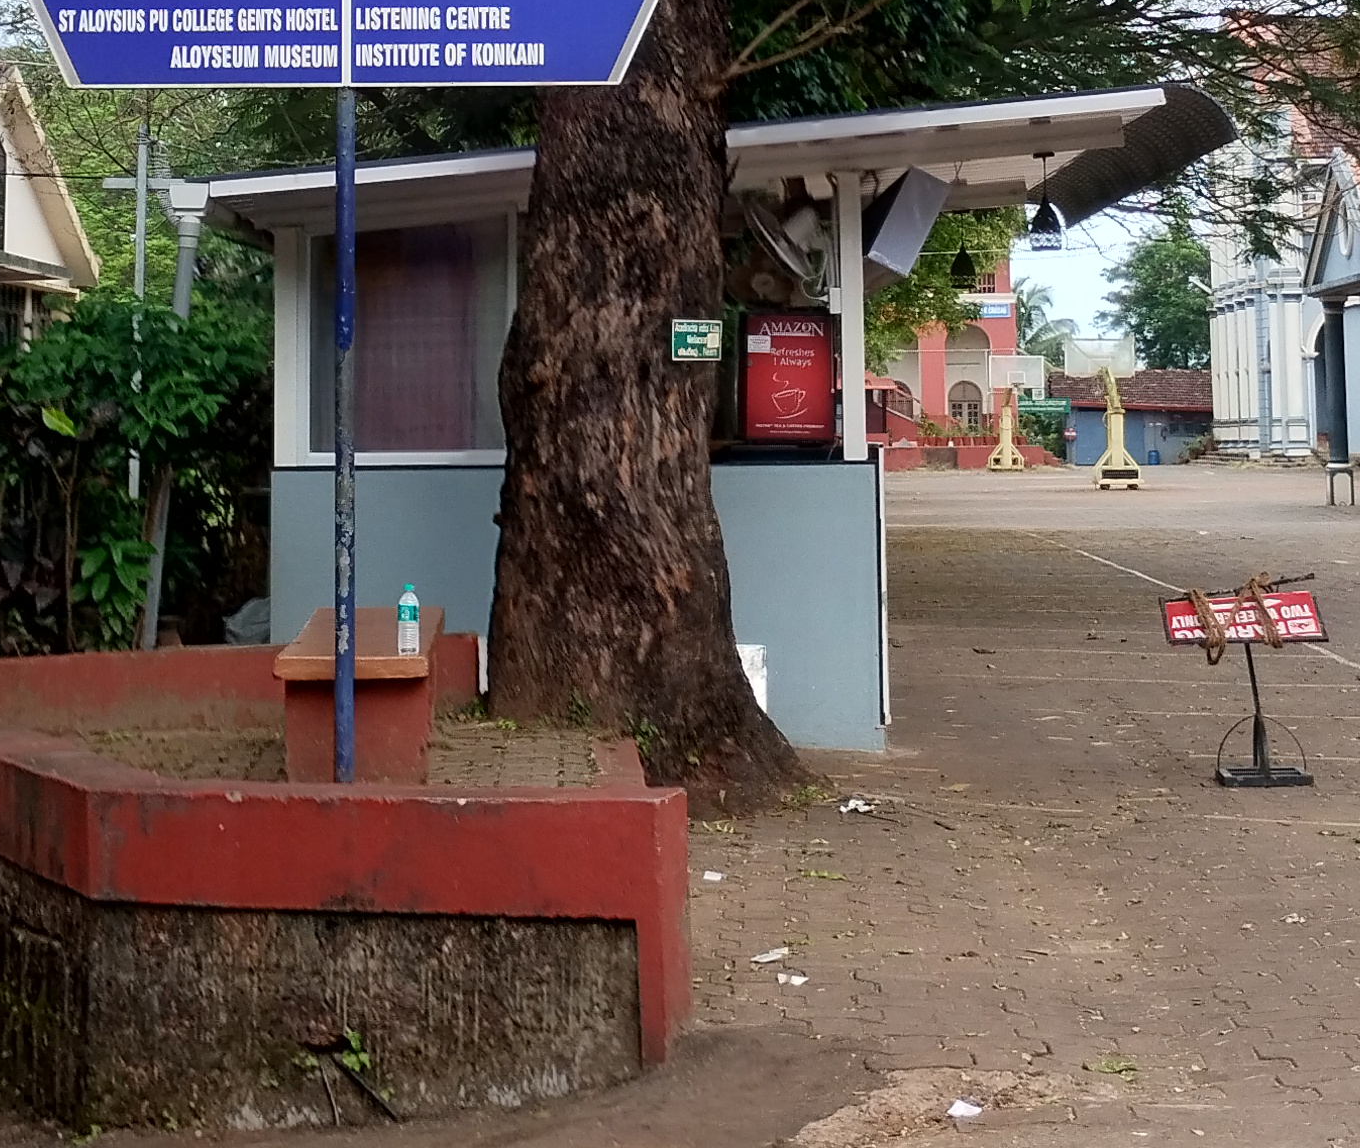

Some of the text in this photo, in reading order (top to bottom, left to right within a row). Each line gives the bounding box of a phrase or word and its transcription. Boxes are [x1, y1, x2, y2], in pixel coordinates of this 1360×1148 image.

[58, 7, 339, 33] ST ALOYSIUS PU COLLEGE GENTS HOSTEL
[355, 6, 511, 30] LISTENING CENTRE
[170, 45, 338, 69] ALOYSEUM MUSEUM
[355, 42, 545, 67] INSTITUTE OF KONKANI
[759, 321, 825, 337] AMAZON
[770, 347, 815, 357] Refreshes
[780, 357, 812, 369] Always
[1280, 604, 1313, 619] TWO
